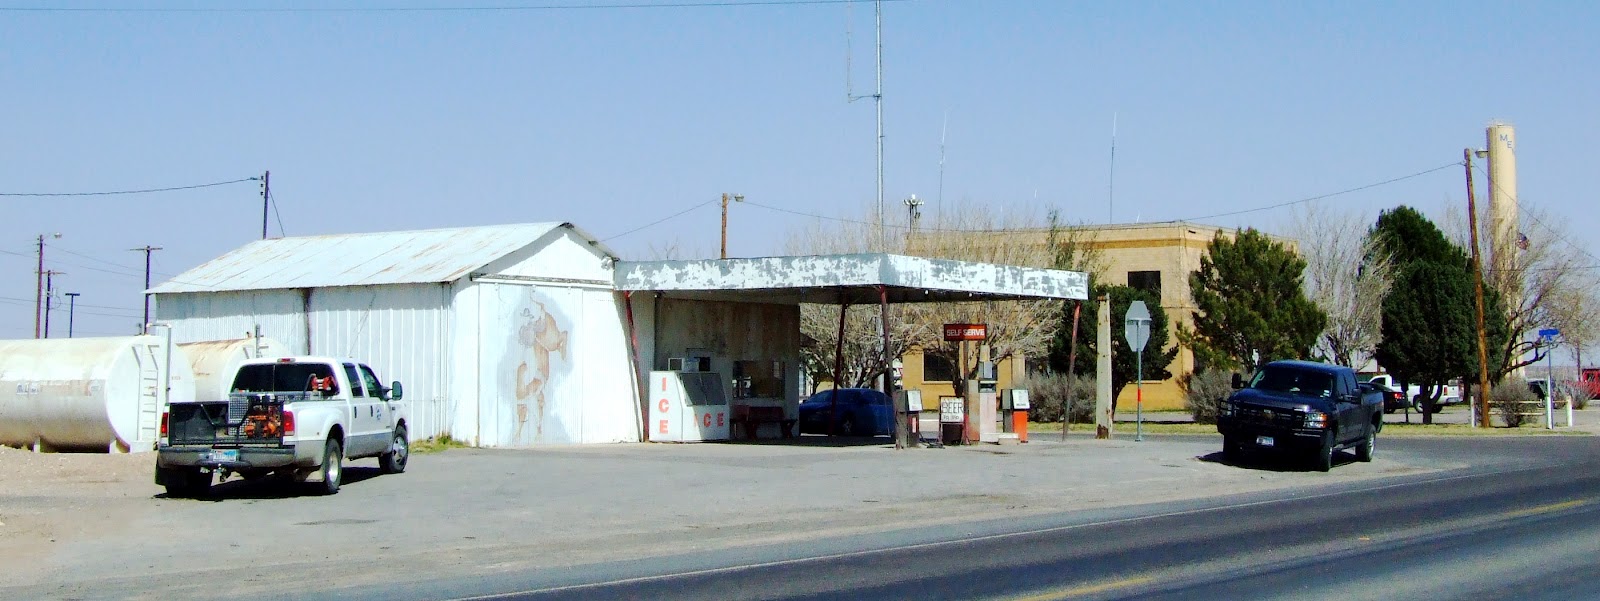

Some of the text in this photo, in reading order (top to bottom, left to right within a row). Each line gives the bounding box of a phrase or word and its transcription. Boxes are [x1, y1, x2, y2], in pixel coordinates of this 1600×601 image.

[946, 328, 986, 337] SELF SERVE
[658, 376, 670, 435] ICE
[941, 401, 965, 414] BEER
